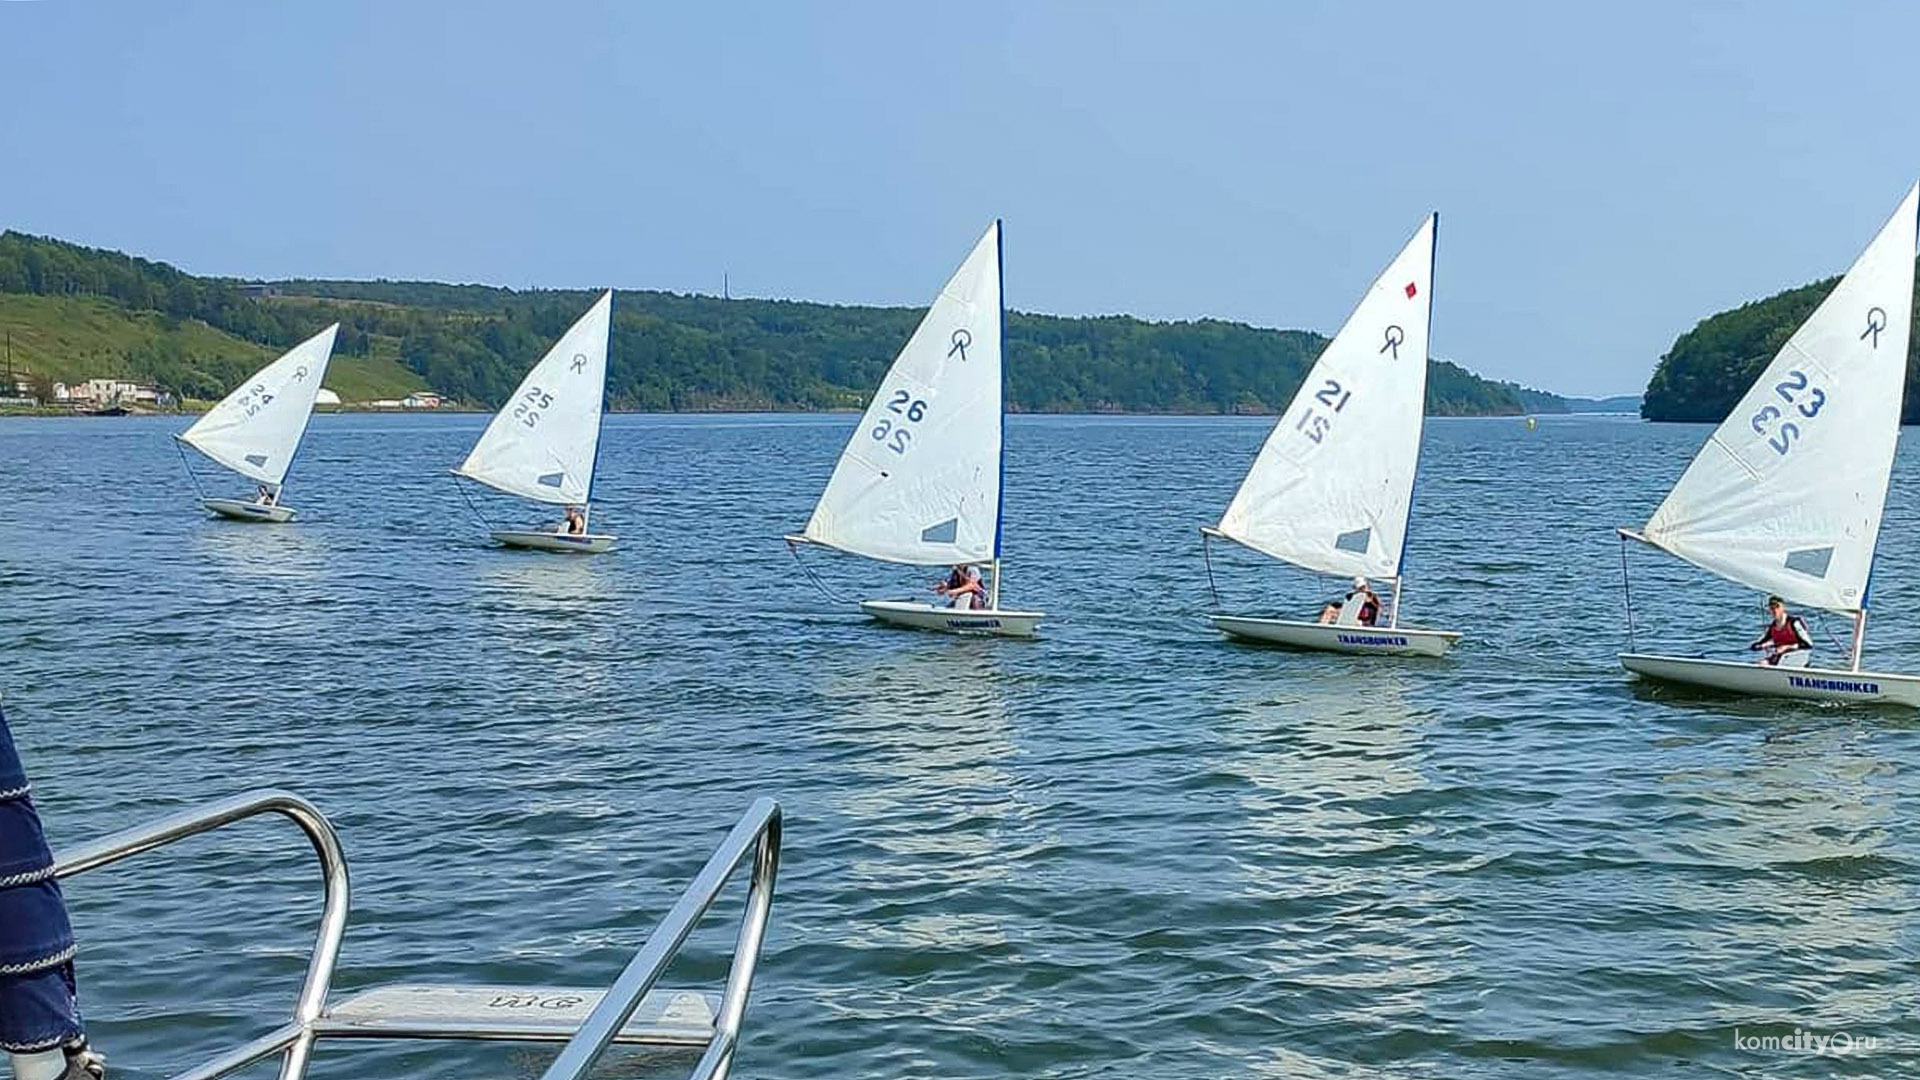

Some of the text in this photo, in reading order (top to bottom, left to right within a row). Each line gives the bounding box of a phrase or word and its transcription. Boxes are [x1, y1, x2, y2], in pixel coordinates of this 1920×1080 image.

[251, 384, 274, 404] 24
[523, 387, 554, 410] 25
[887, 389, 928, 423] 26
[1315, 379, 1351, 413] 21
[1775, 370, 1825, 418] 23
[1788, 675, 1879, 694] TRANSBUNKER
